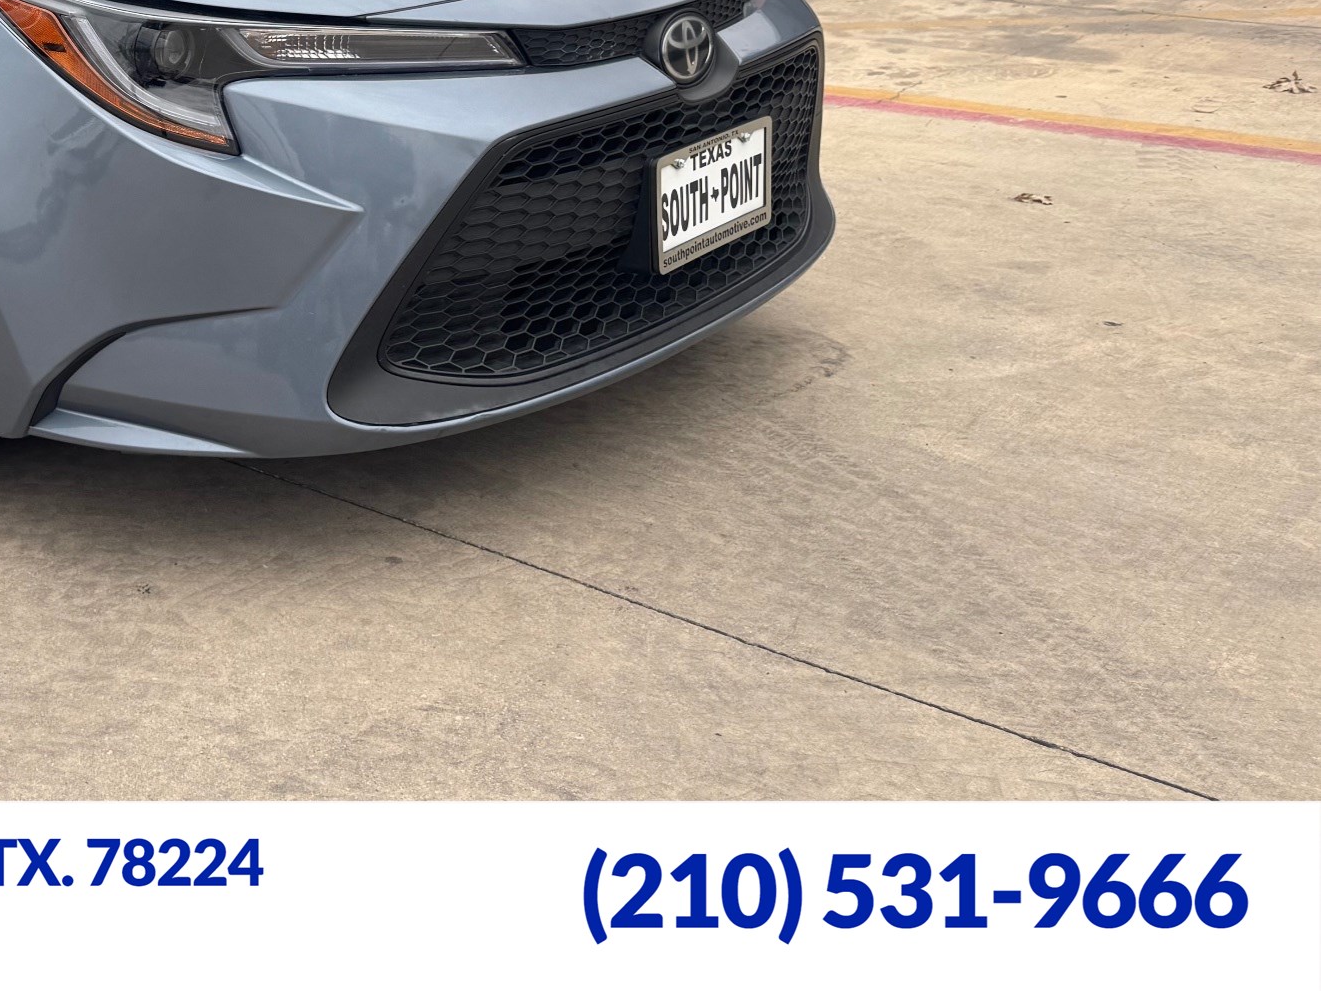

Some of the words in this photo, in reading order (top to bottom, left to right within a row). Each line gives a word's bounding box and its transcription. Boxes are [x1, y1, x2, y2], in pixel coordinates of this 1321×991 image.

[689, 145, 701, 153] SAN
[690, 140, 732, 171] TEXAS
[661, 175, 709, 242] SOUTH
[721, 153, 762, 213] POINT
[663, 212, 767, 267] southpointautomotive.com
